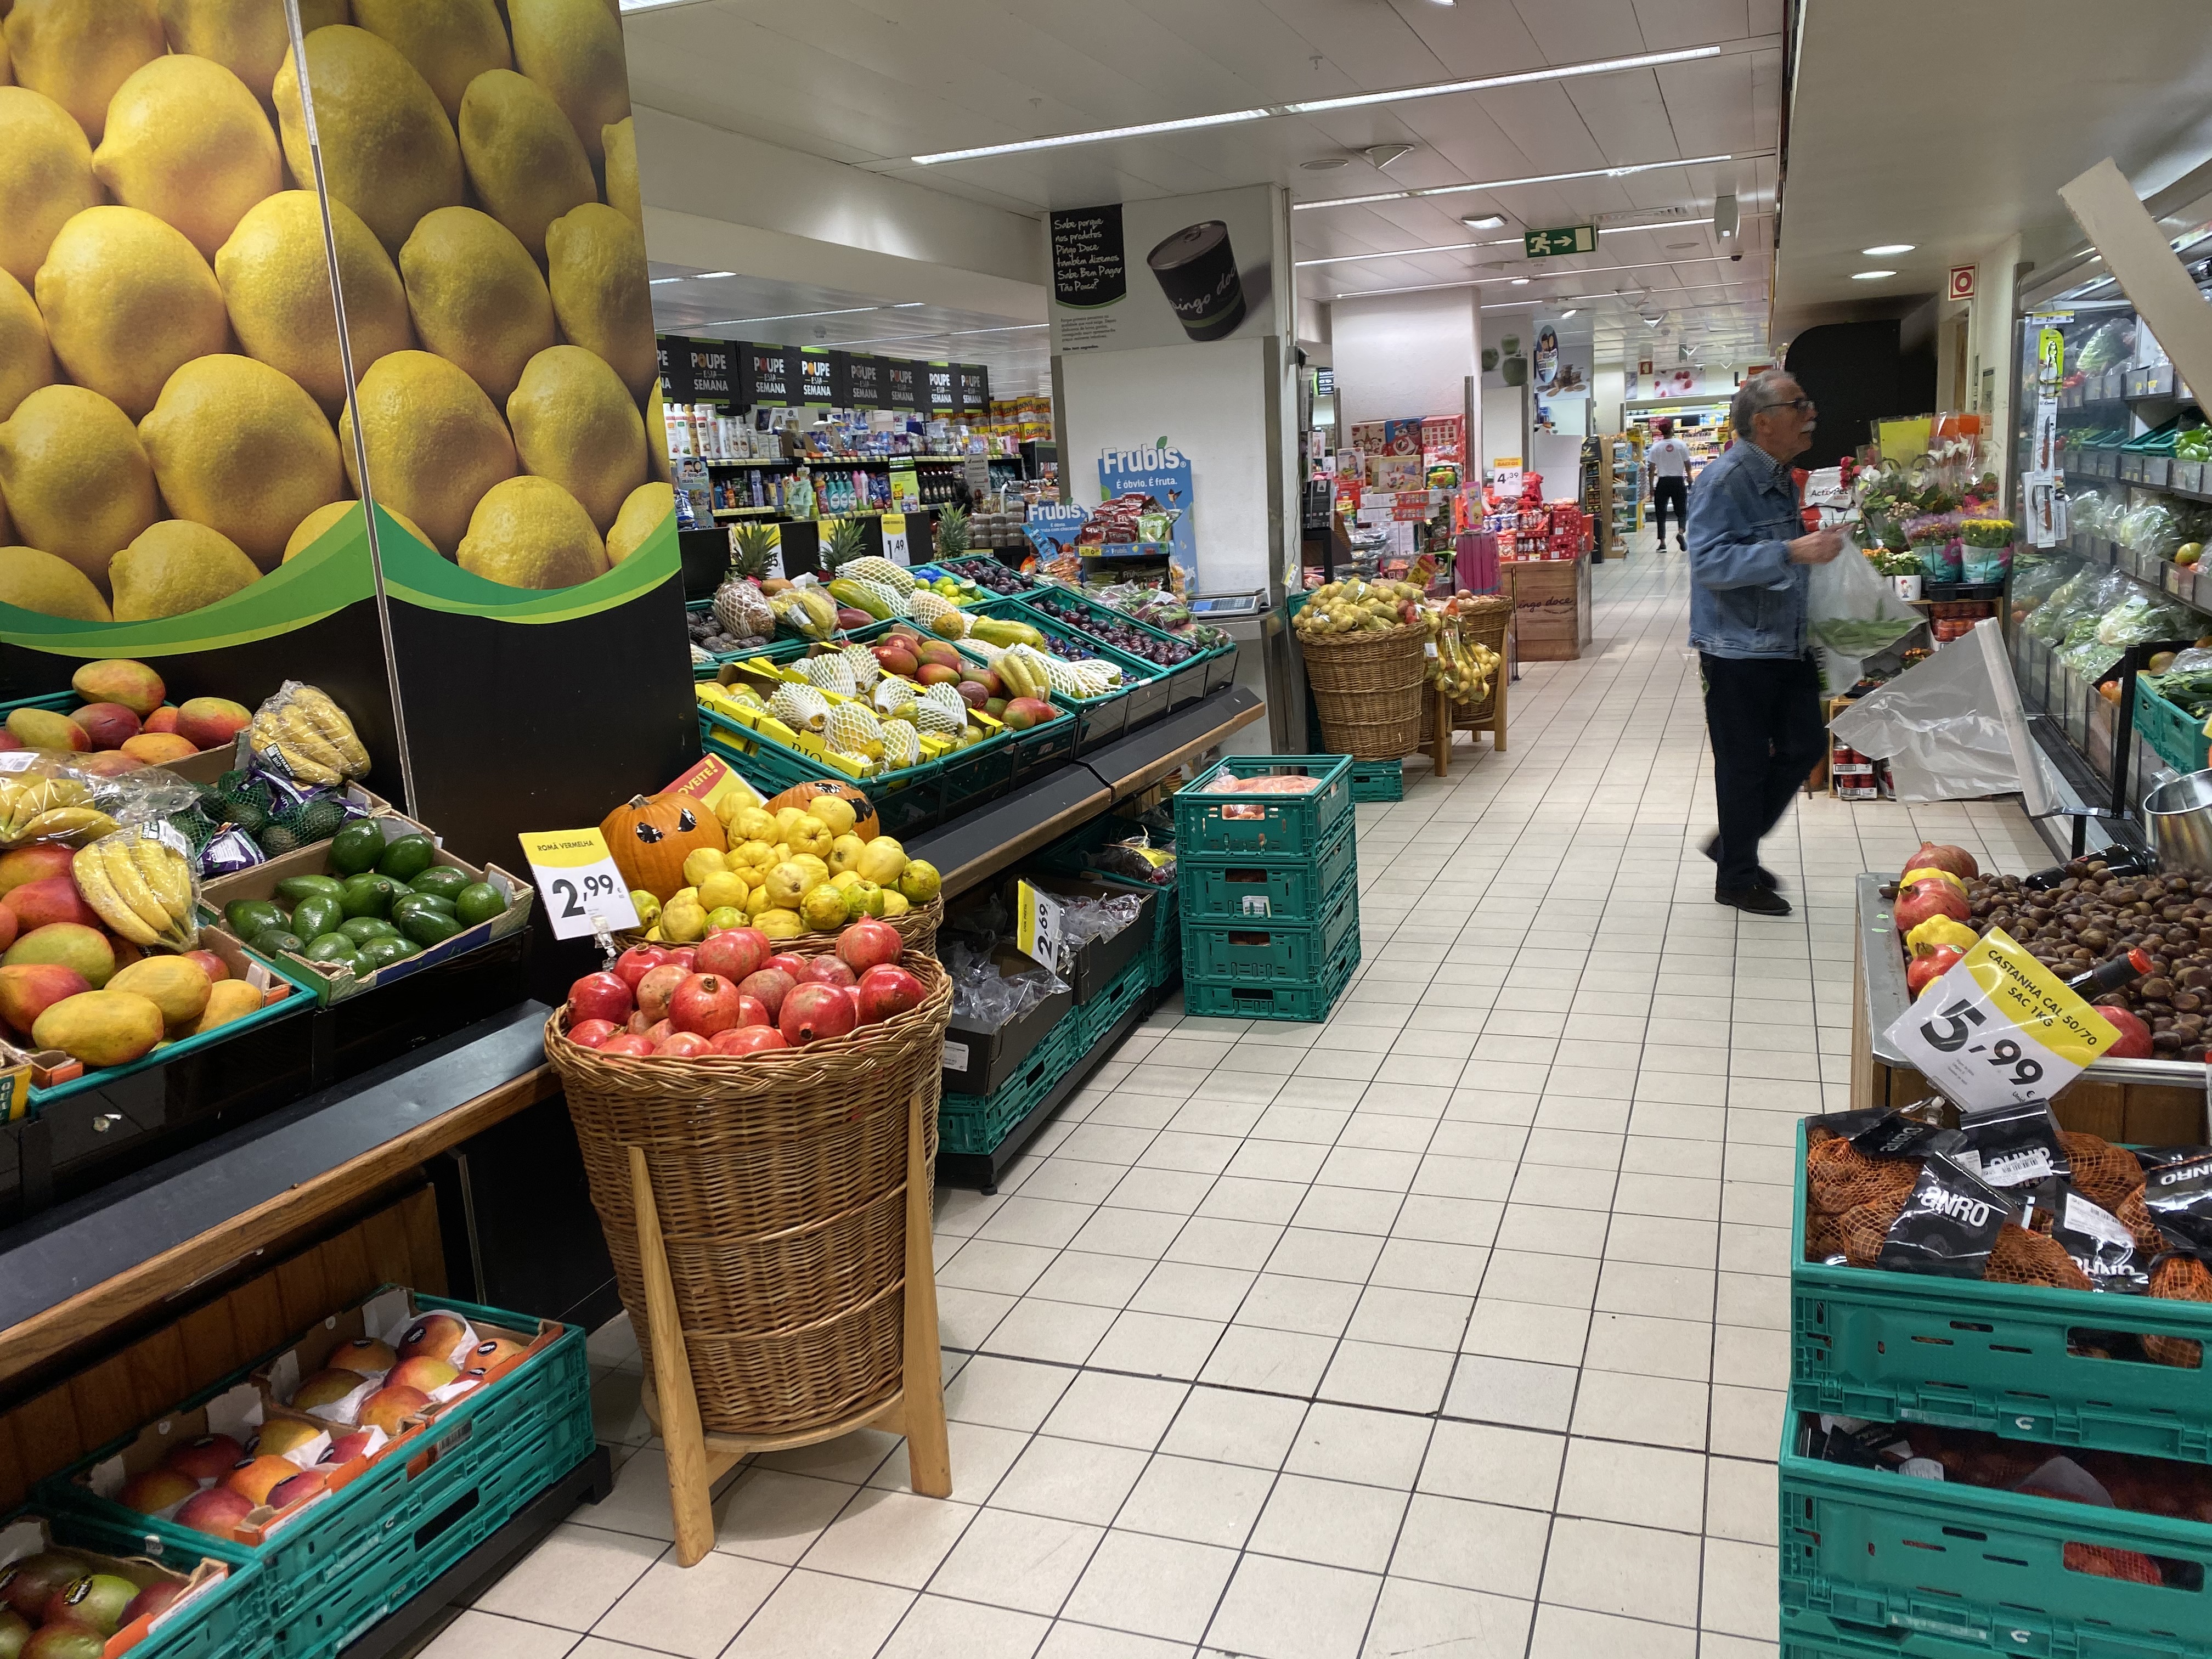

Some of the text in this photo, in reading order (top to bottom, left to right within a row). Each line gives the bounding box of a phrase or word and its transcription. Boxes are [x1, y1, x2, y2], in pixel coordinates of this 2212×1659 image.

[1054, 218, 1076, 229] Sabe
[1070, 229, 1102, 244] produtos
[1056, 242, 1099, 257] Pingo Doce
[1057, 253, 1120, 268] também dizemos
[1058, 265, 1122, 280] Sabe Bem Pagar
[1058, 278, 1099, 292] Tão Pouco?
[690, 352, 727, 369] POUPE
[753, 357, 785, 373] POUPE
[802, 360, 830, 376] POUPE
[693, 379, 729, 391] SEMANA
[929, 373, 950, 386] POUPE
[756, 383, 786, 394] SEMANA
[803, 385, 832, 396] SEMANA
[853, 387, 877, 399] SEMANA
[891, 391, 913, 402] SEMANA
[931, 394, 952, 403] SEMANA
[963, 394, 982, 403] SEMANA
[1102, 444, 1180, 474] Frubis
[1116, 476, 1177, 488] É óbvio. É fruta.
[1497, 472, 1519, 484] 4,39
[1028, 502, 1081, 521] Frubis
[887, 539, 904, 559] 1,49
[1545, 596, 1573, 606] doce
[272, 757, 281, 767] BIO
[273, 744, 291, 772] GREENYARD
[537, 840, 594, 851] ROMÃ VERMELHA
[552, 874, 613, 918] 2,99
[1037, 904, 1052, 961] 2,69
[1988, 949, 2097, 1046] CASTANHA CAL 50/70
[2007, 986, 2055, 1028] SAC 1KG
[1920, 998, 2044, 1086] 5,99
